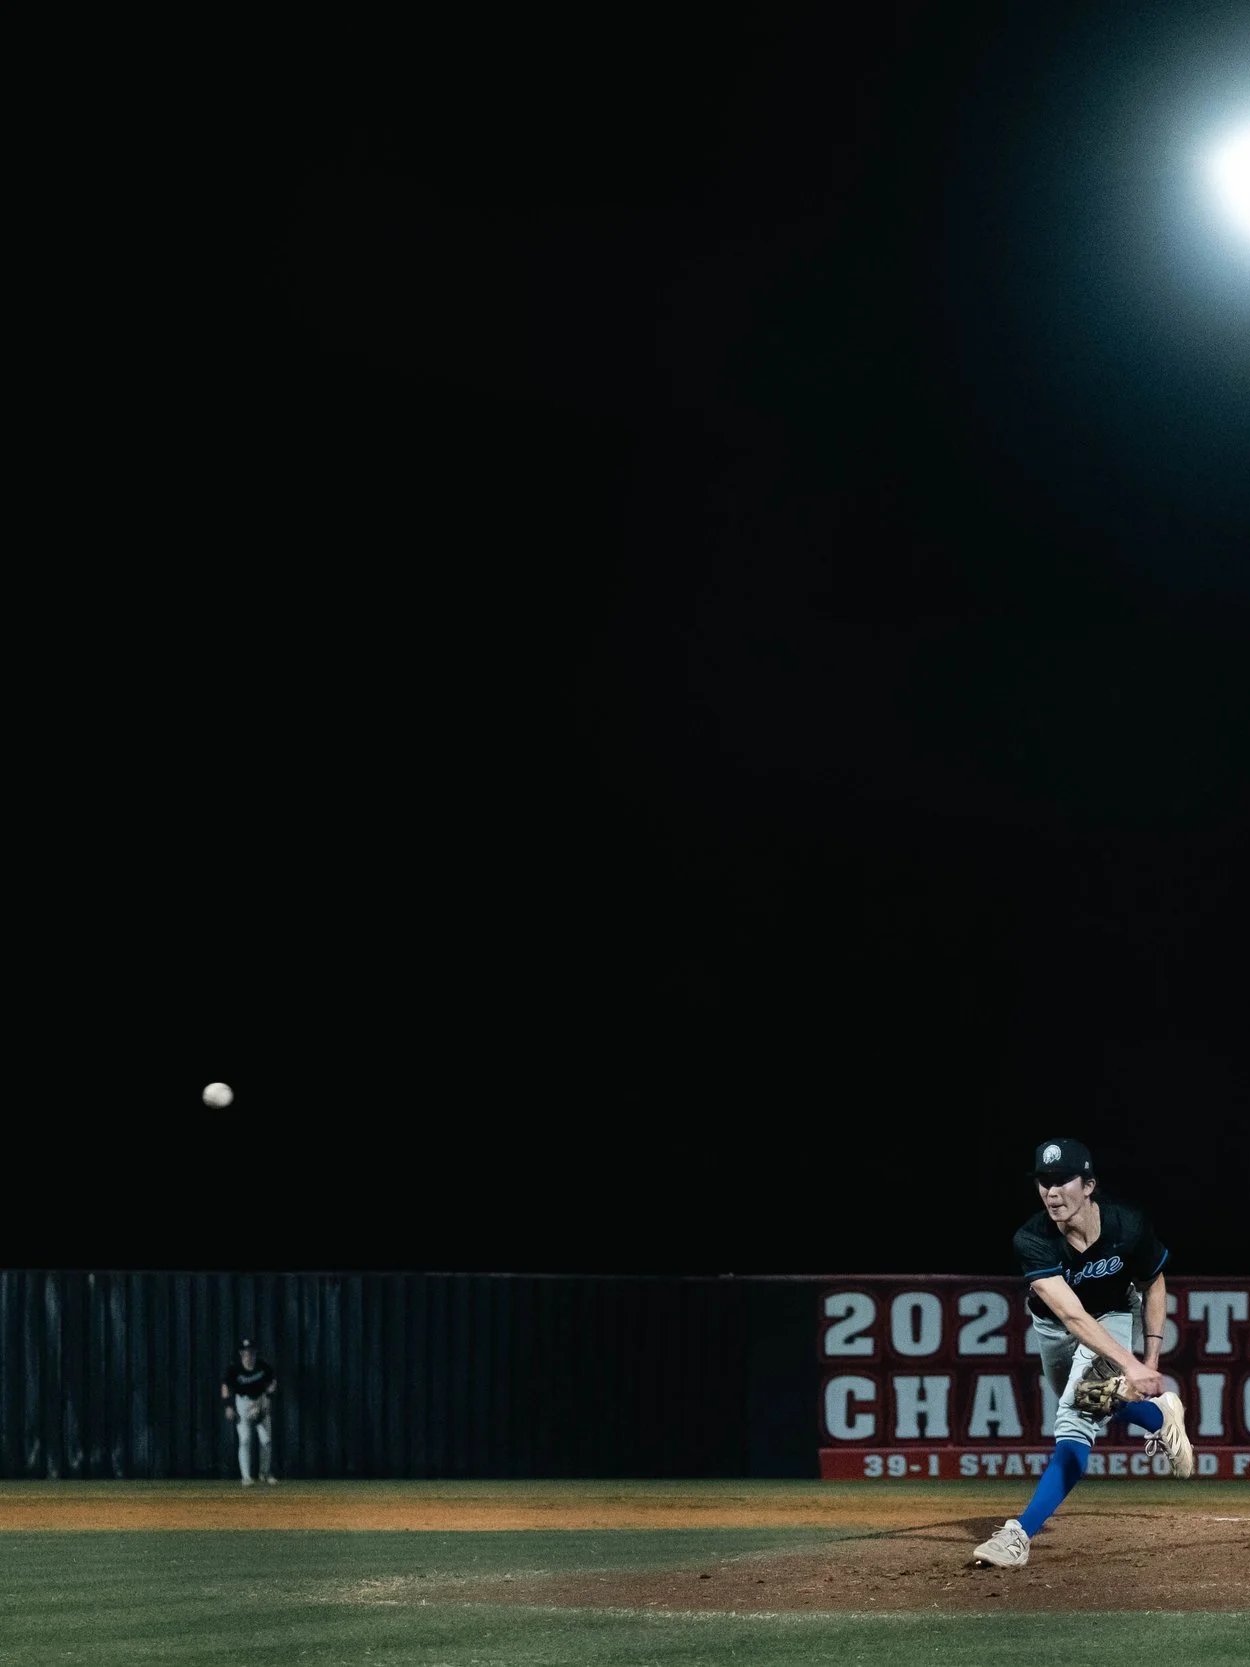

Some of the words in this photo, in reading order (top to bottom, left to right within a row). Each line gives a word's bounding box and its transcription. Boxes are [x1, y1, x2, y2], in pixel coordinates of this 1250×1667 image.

[825, 1291, 1043, 1356] 202
[864, 1454, 939, 1477] 39-1
[960, 1453, 1056, 1477] STAT
[1087, 1453, 1219, 1476] RECOD
